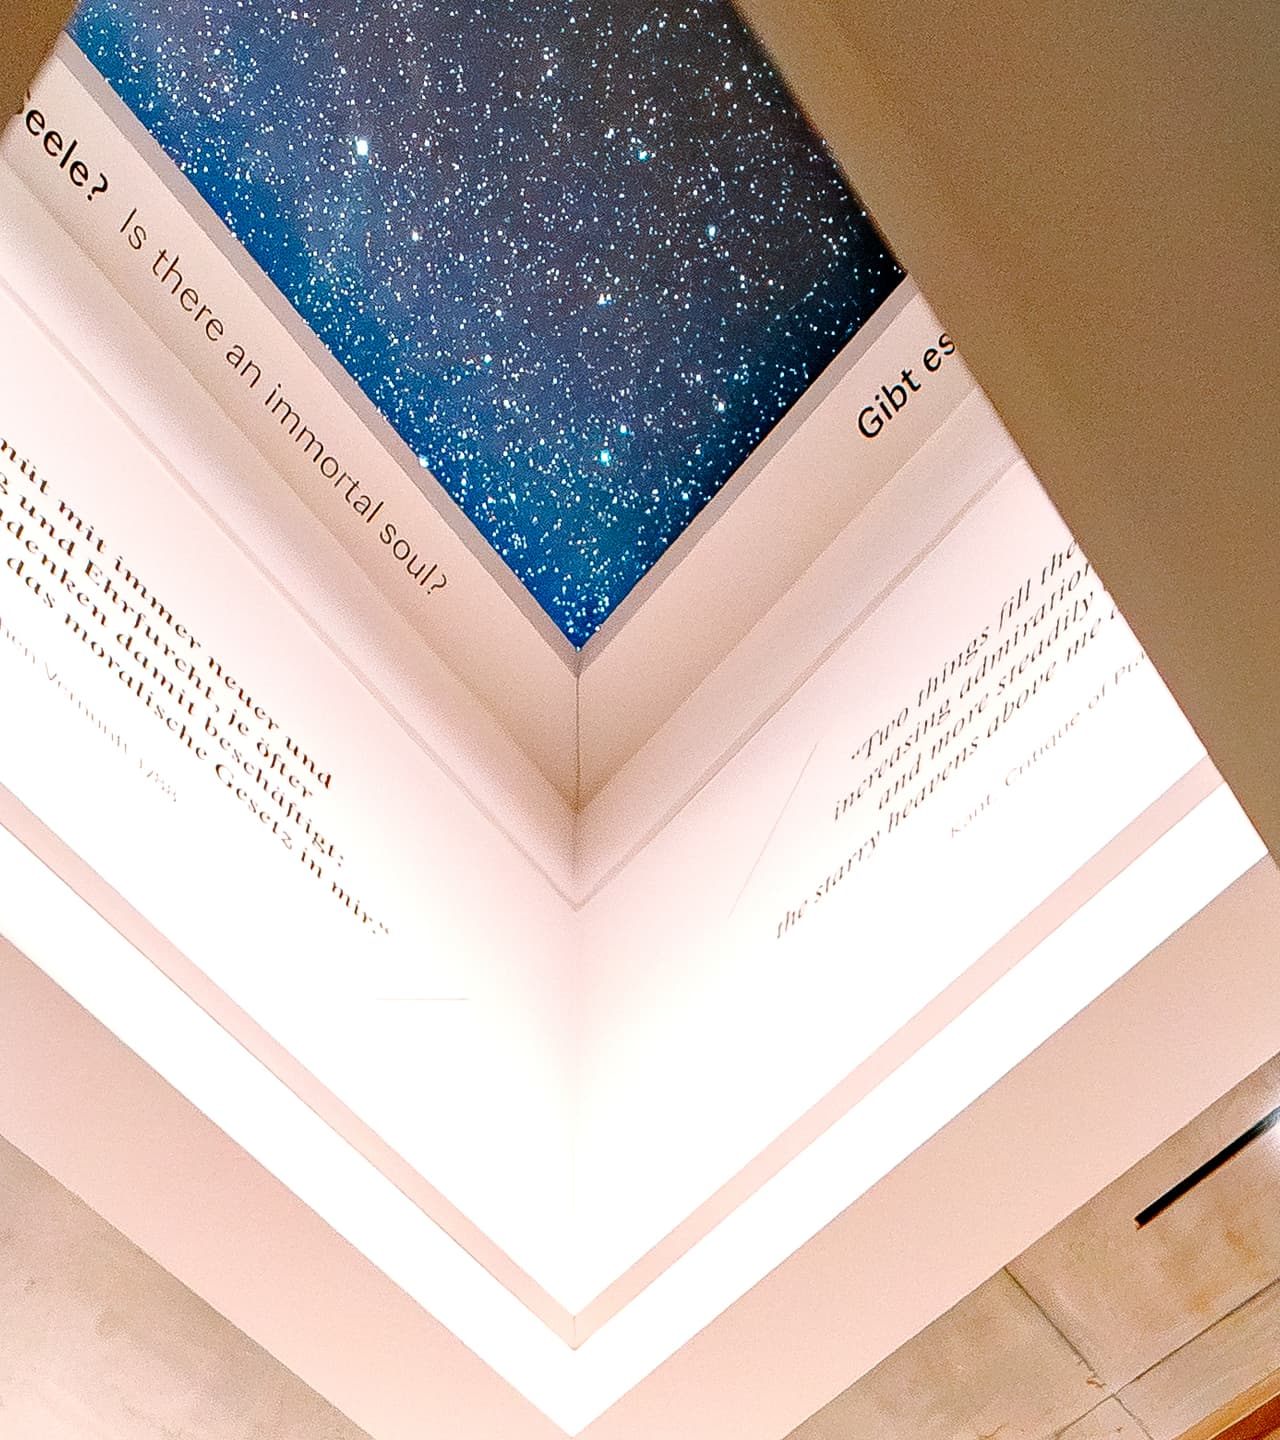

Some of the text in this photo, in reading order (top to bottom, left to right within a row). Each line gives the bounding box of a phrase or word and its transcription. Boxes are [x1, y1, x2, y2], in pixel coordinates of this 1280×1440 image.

[118, 207, 152, 253] Is
[152, 248, 227, 345] there
[224, 337, 262, 389] an
[263, 383, 384, 523] immortal
[379, 519, 449, 596] soul?
[856, 330, 958, 440] Gibt es
[5, 556, 57, 610] das
[63, 611, 210, 763] moralische
[213, 763, 297, 852] Gesetz
[300, 847, 325, 880] in
[18, 493, 78, 558] und
[83, 560, 221, 715] Ehrfurcht,
[227, 708, 252, 737] je
[256, 739, 316, 803] öfter
[58, 498, 108, 555] mit
[113, 555, 202, 651] immer
[207, 656, 282, 732] neuer
[284, 734, 335, 792] und
[115, 629, 197, 718] damit
[204, 717, 346, 869] beschäftigt:
[877, 588, 1095, 812] and more steadily
[917, 623, 991, 708] things
[997, 577, 1032, 628] fill
[1039, 540, 1079, 587] the
[776, 621, 1103, 940] the starry heavens above me
[833, 700, 952, 823] increasing
